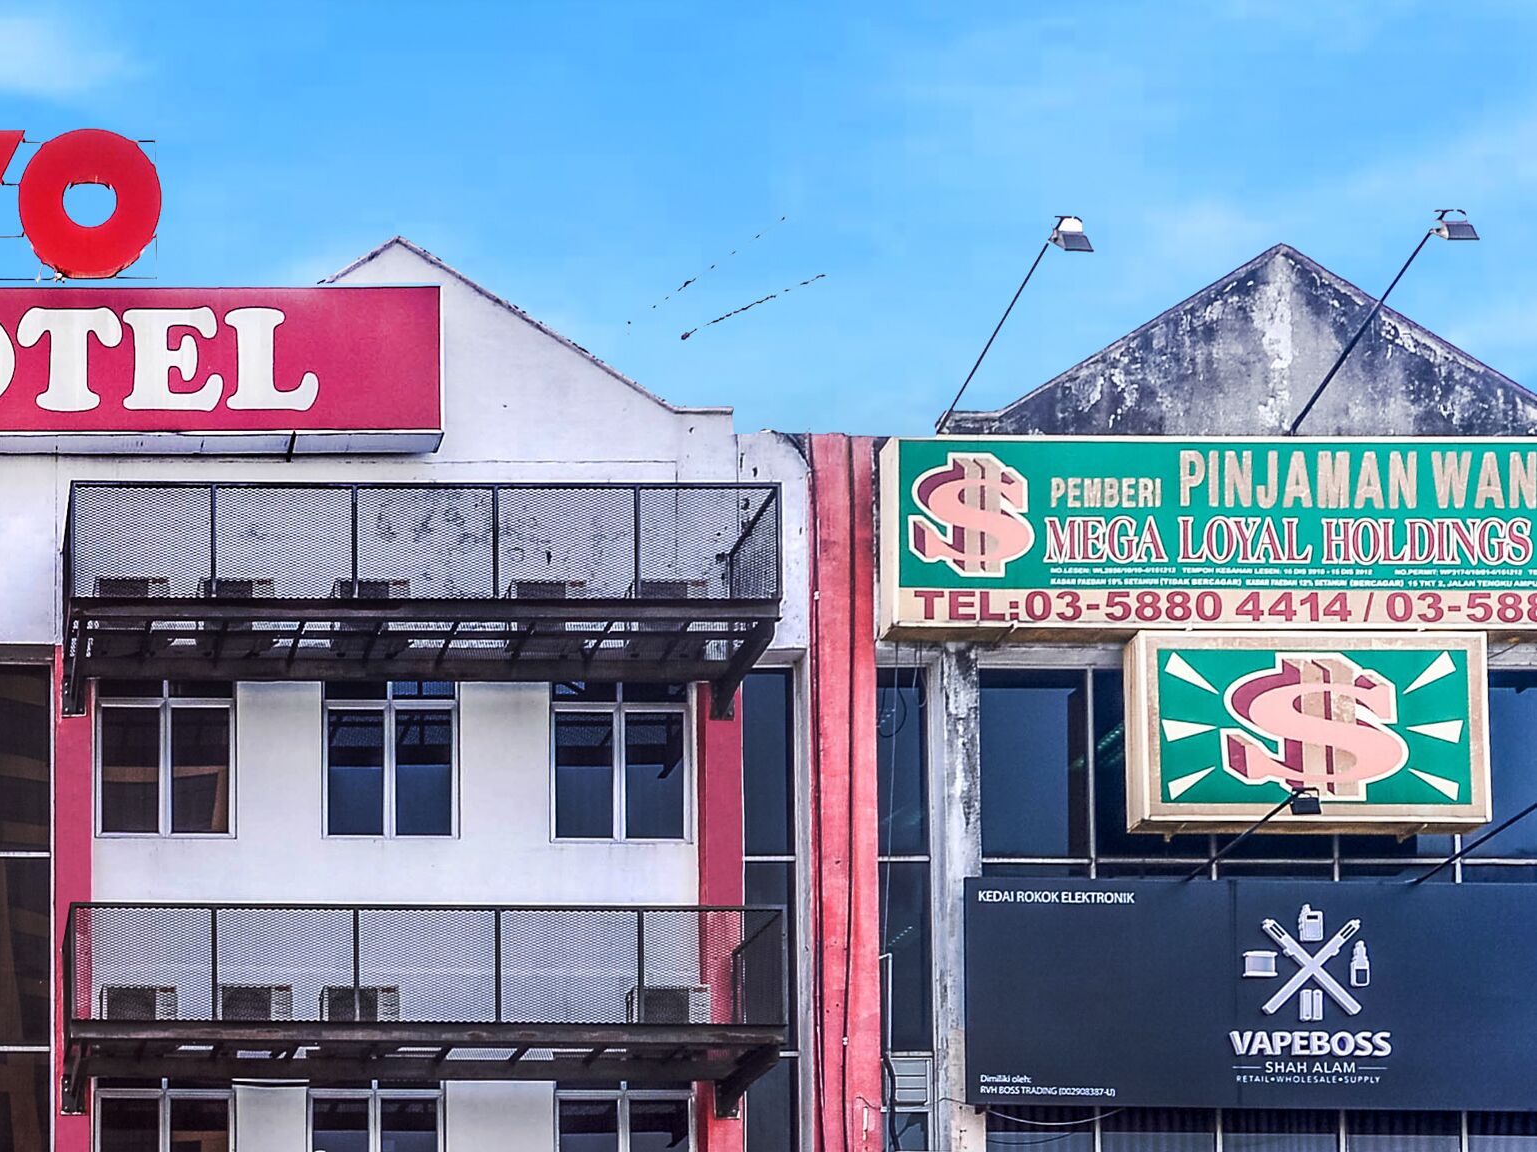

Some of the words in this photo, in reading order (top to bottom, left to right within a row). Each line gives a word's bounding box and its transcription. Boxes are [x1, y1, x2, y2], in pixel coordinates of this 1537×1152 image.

[1050, 476, 1162, 508] PEMBERI
[1179, 449, 1417, 508] PINJAMAN
[1432, 450, 1537, 510] WAN
[1043, 515, 1172, 564] MEGA
[1178, 516, 1313, 564] LOYAL
[1321, 516, 1534, 566] HOLDINGS
[914, 590, 1223, 622] TEL:03-5880
[1236, 591, 1351, 622] 4414
[978, 890, 1014, 903] KEDAI
[1016, 890, 1058, 904] ROKOK
[1060, 891, 1135, 905] ELEKTRONIK
[1229, 1031, 1392, 1057] VAPEBOSS
[1265, 1061, 1307, 1073] SHAH
[1312, 1062, 1355, 1073] ALAM
[999, 1086, 1019, 1094] BOSS
[1021, 1086, 1057, 1095] TRADING
